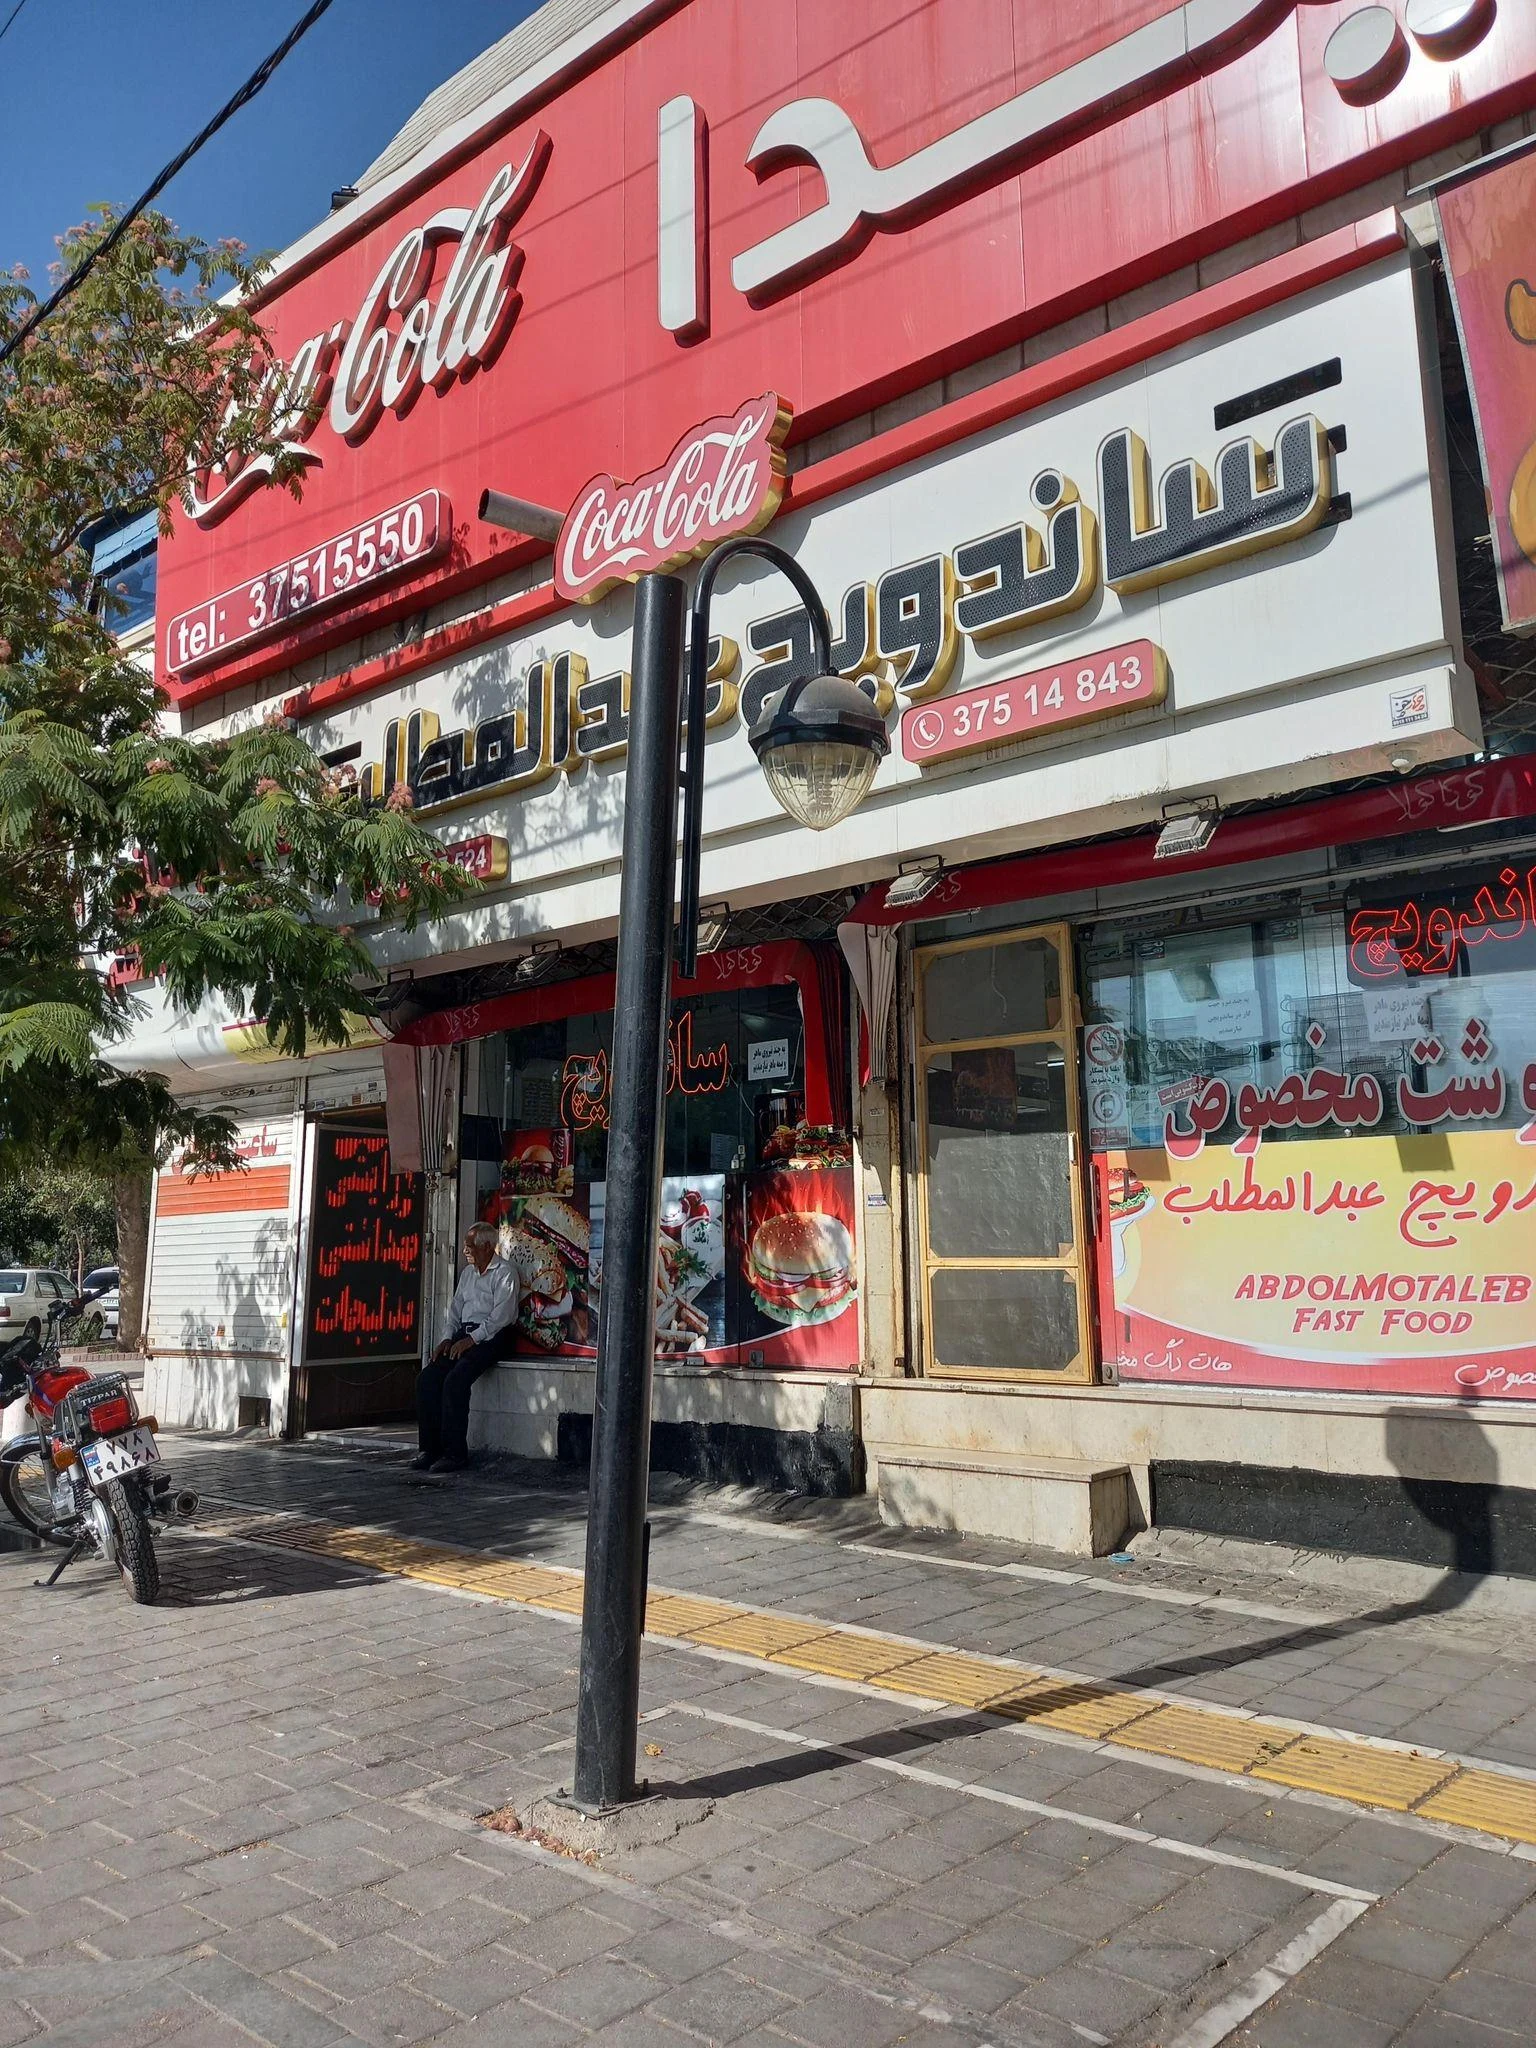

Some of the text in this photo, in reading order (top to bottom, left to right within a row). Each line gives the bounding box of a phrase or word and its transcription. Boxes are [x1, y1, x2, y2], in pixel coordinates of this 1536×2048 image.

[177, 502, 424, 662] tel: 37515550
[952, 655, 1142, 737] 375 14 843
[1163, 1022, 1384, 1159] مخصوص
[1163, 1154, 1387, 1225] عبدالمطلب
[1233, 1272, 1534, 1303] ABDOLMOTALEB
[1292, 1307, 1474, 1336] FAST FOOD
